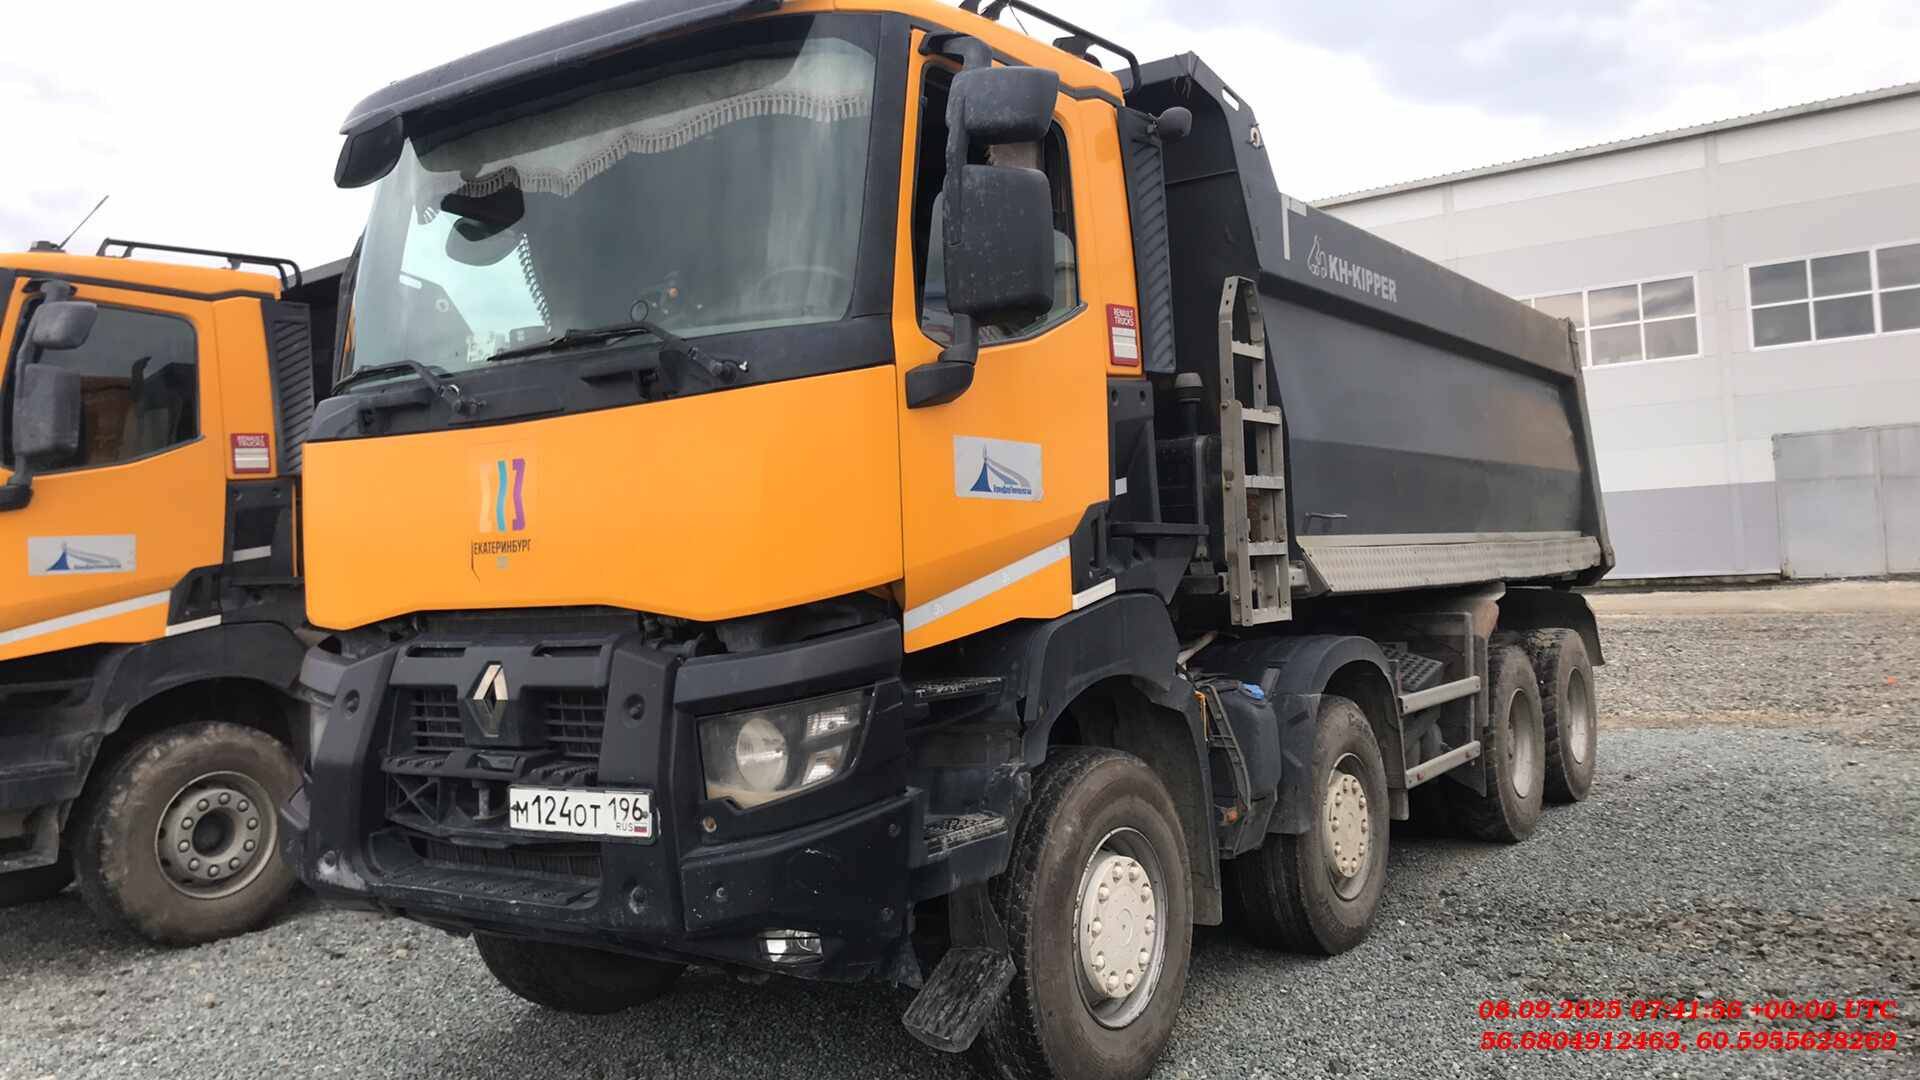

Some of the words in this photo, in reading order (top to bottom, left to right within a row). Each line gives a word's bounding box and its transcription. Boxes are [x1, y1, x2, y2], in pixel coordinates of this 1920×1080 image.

[1328, 254, 1398, 303] KH-KIPPER
[473, 538, 532, 555] ЕКАТЕРИНБУРГ
[515, 794, 601, 829] М124ОТ
[608, 796, 643, 821] 196
[615, 822, 634, 833] RUS
